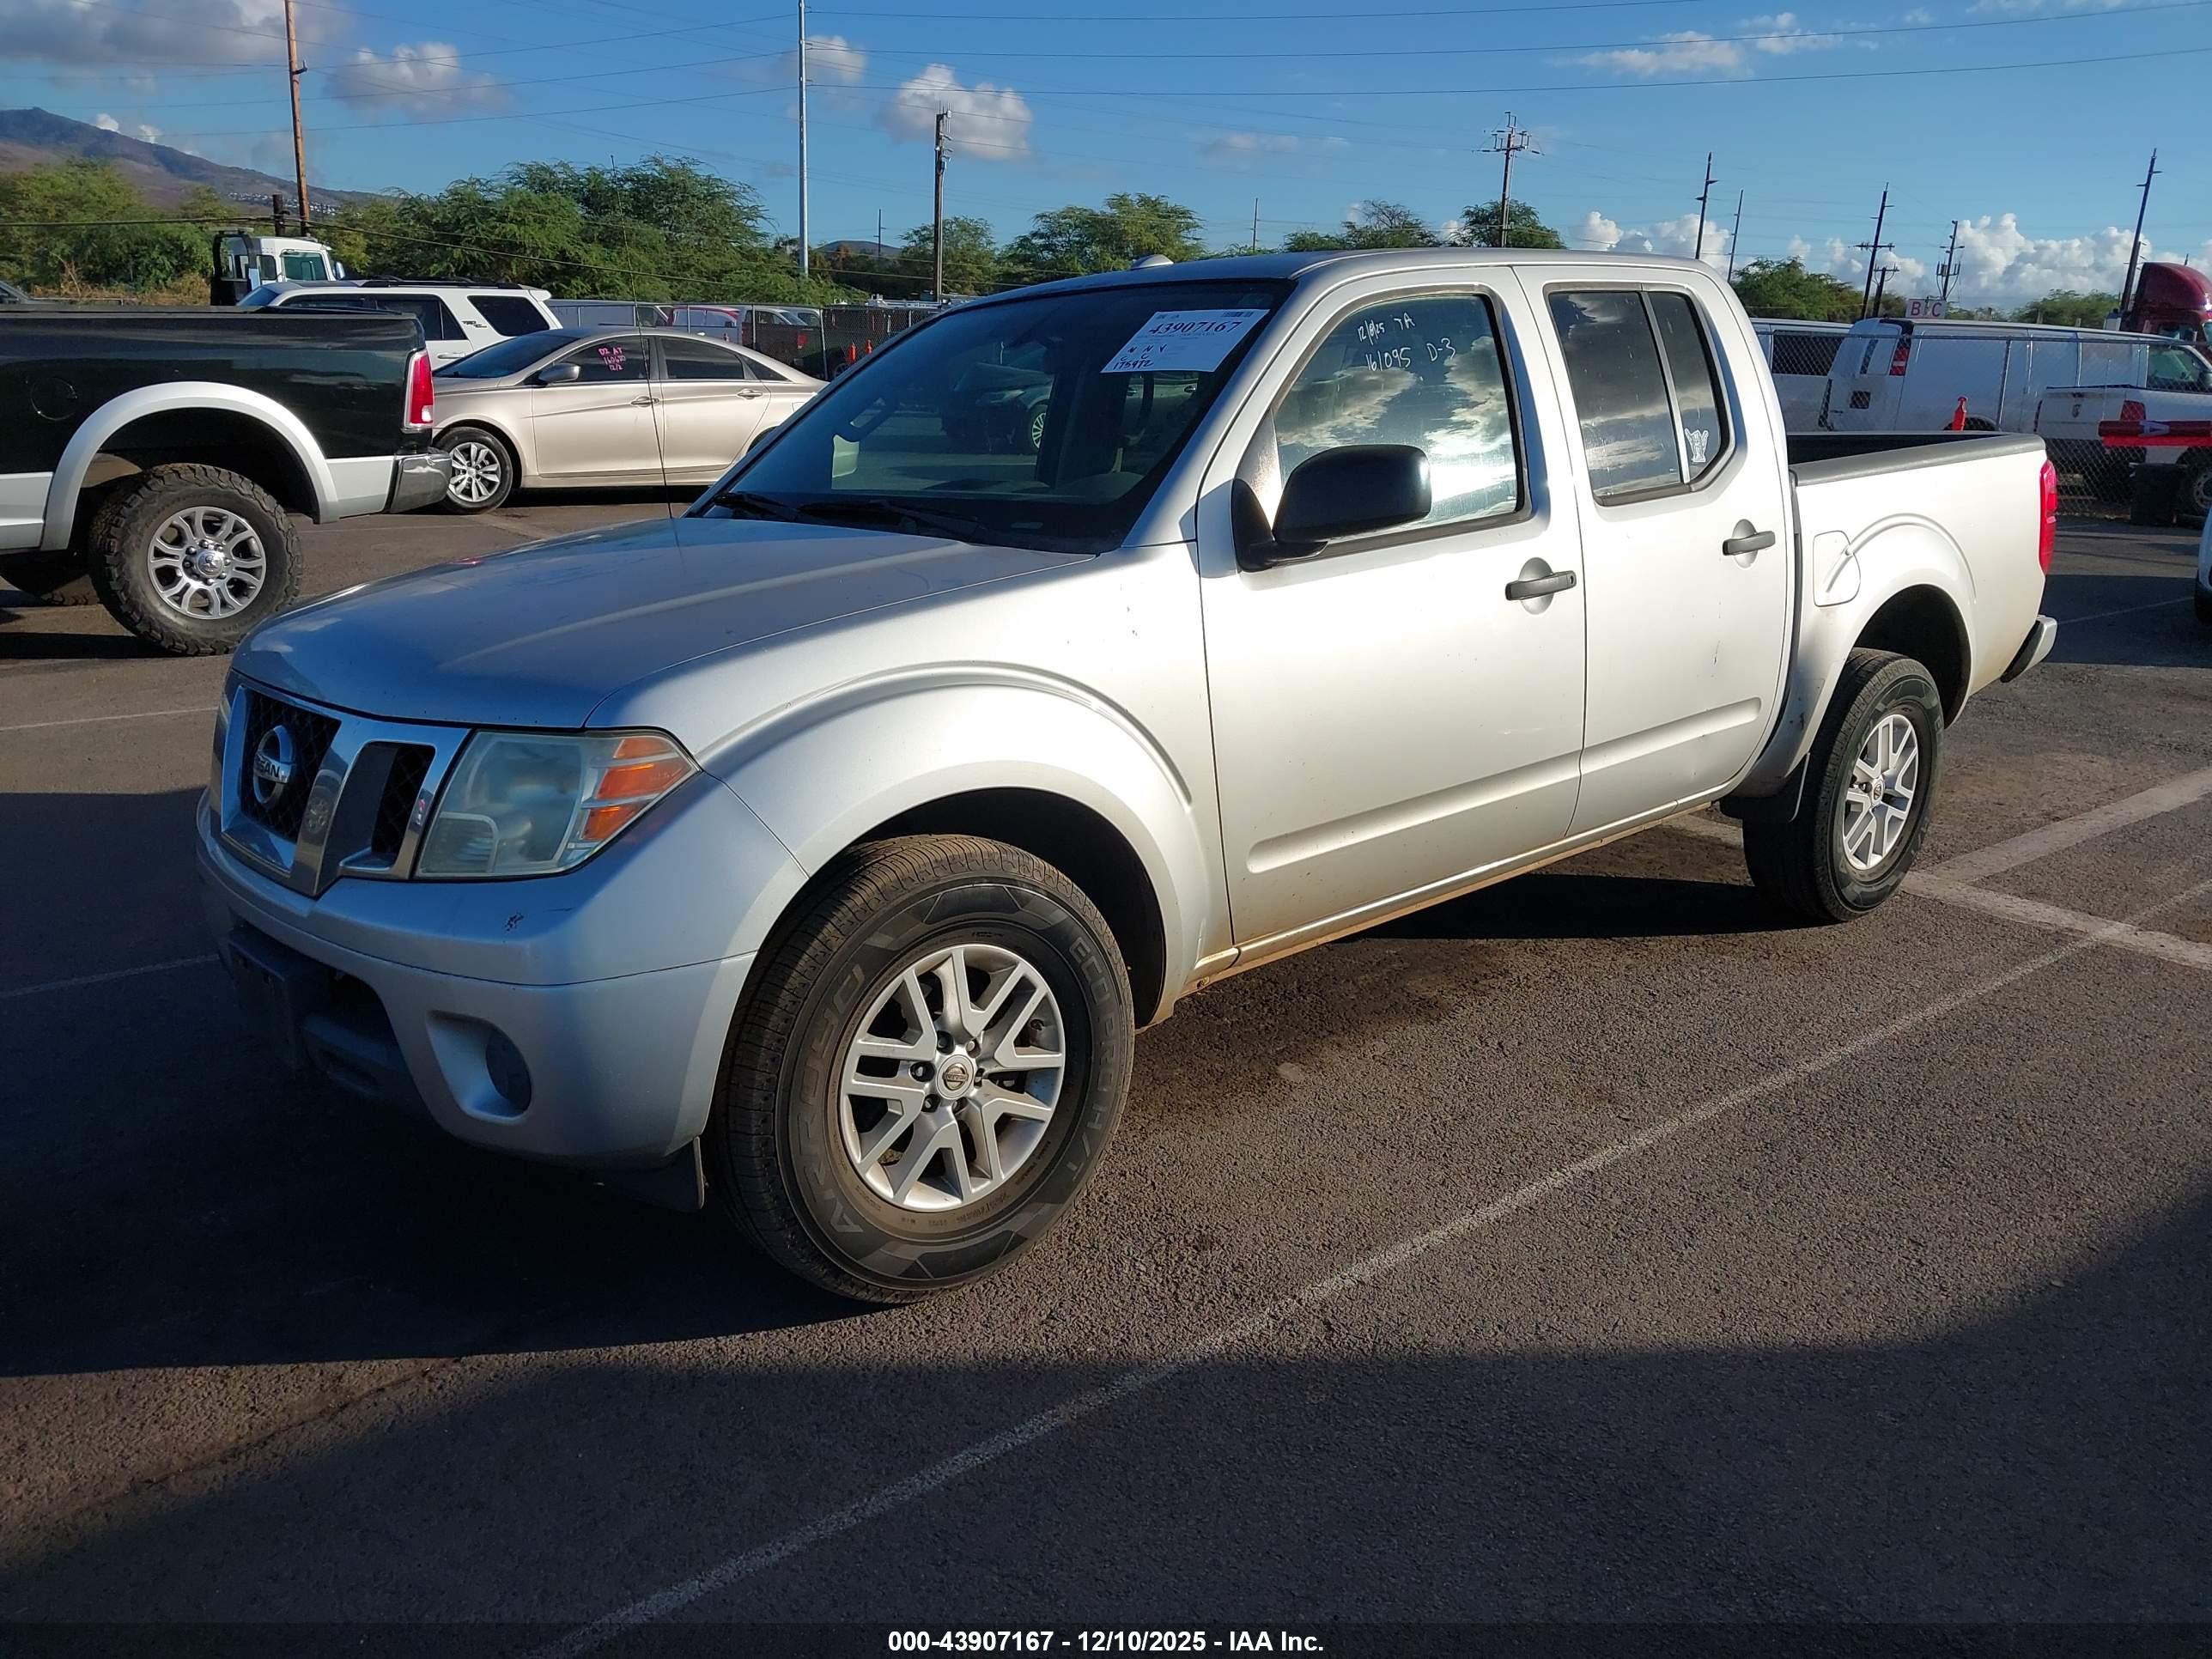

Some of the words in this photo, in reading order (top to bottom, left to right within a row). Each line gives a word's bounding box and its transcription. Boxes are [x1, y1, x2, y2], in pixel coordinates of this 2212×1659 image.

[1149, 321, 1243, 334] 43907167
[1394, 312, 1415, 331] TA
[1426, 337, 1455, 362] D-3
